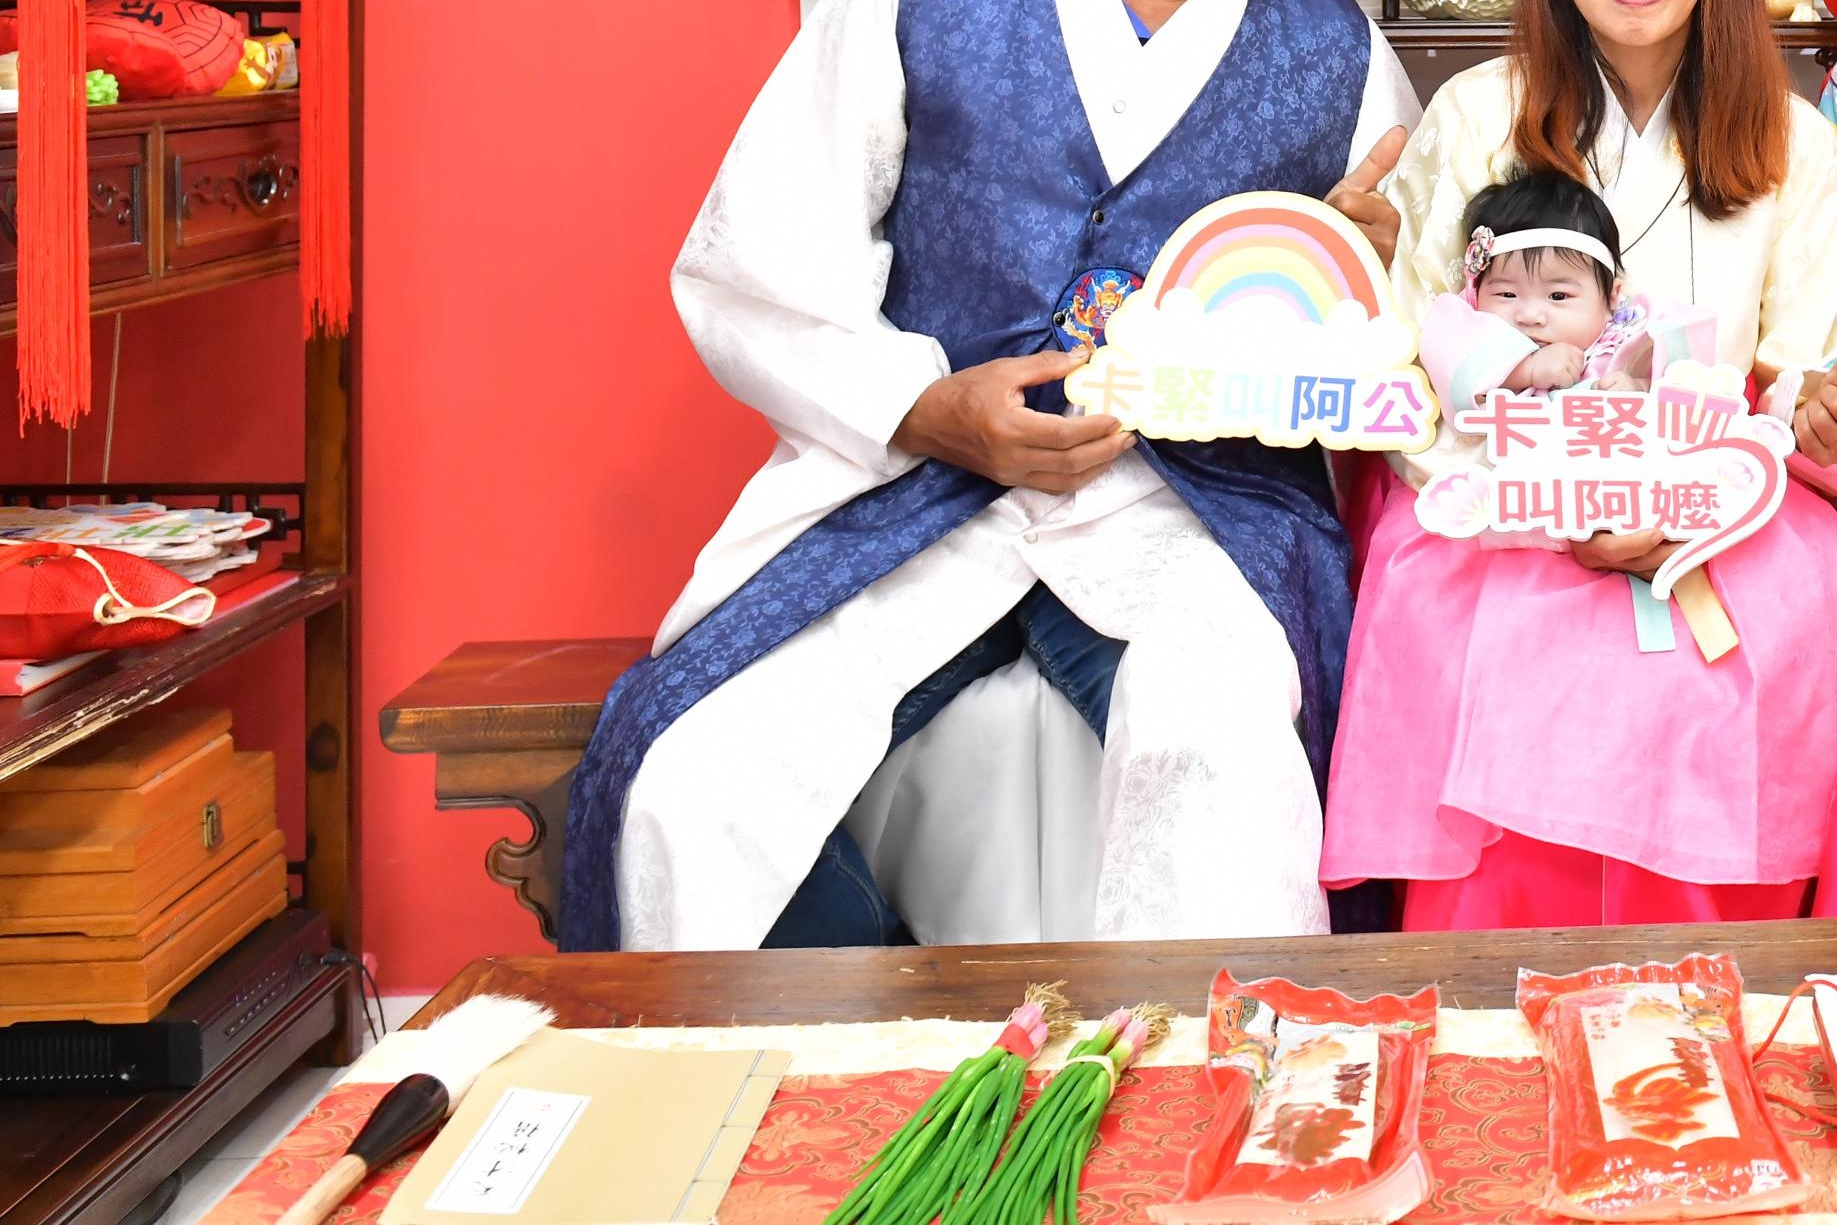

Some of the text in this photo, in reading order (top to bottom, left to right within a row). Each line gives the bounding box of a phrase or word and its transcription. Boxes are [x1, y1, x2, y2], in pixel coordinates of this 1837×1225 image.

[1081, 362, 1424, 436] 卡緊叫阿公
[1463, 394, 1648, 459] 卡緊
[1497, 478, 1722, 530] 叫阿嬤
